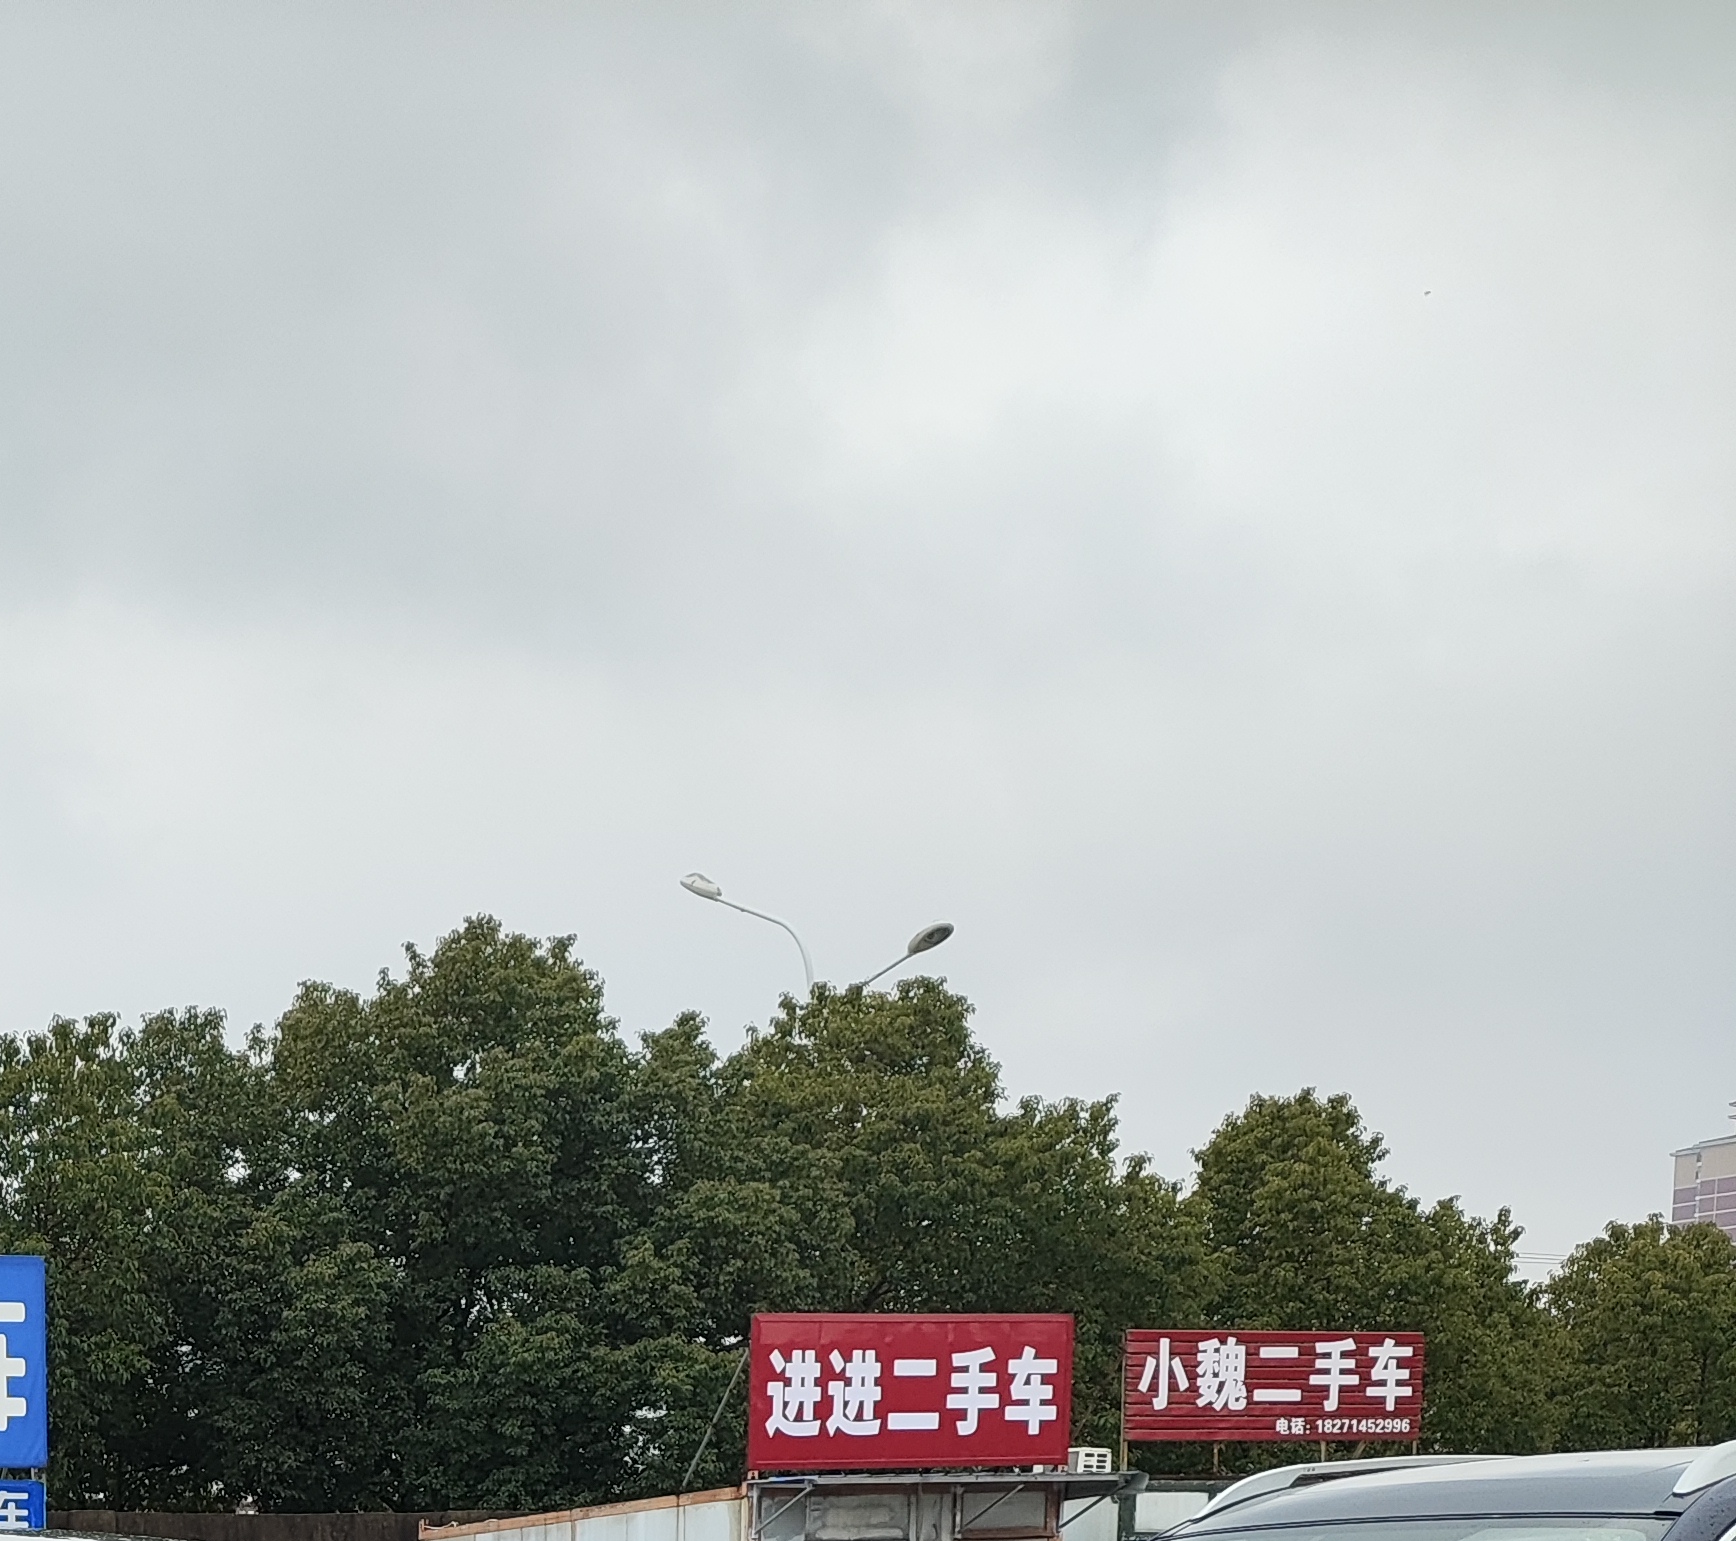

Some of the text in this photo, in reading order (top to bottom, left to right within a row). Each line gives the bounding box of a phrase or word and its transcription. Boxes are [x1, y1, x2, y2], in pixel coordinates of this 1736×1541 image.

[765, 1345, 1058, 1438] 进进二手车
[1137, 1336, 1413, 1412] 小魏二手车
[1315, 1419, 1410, 1433] 18271452996
